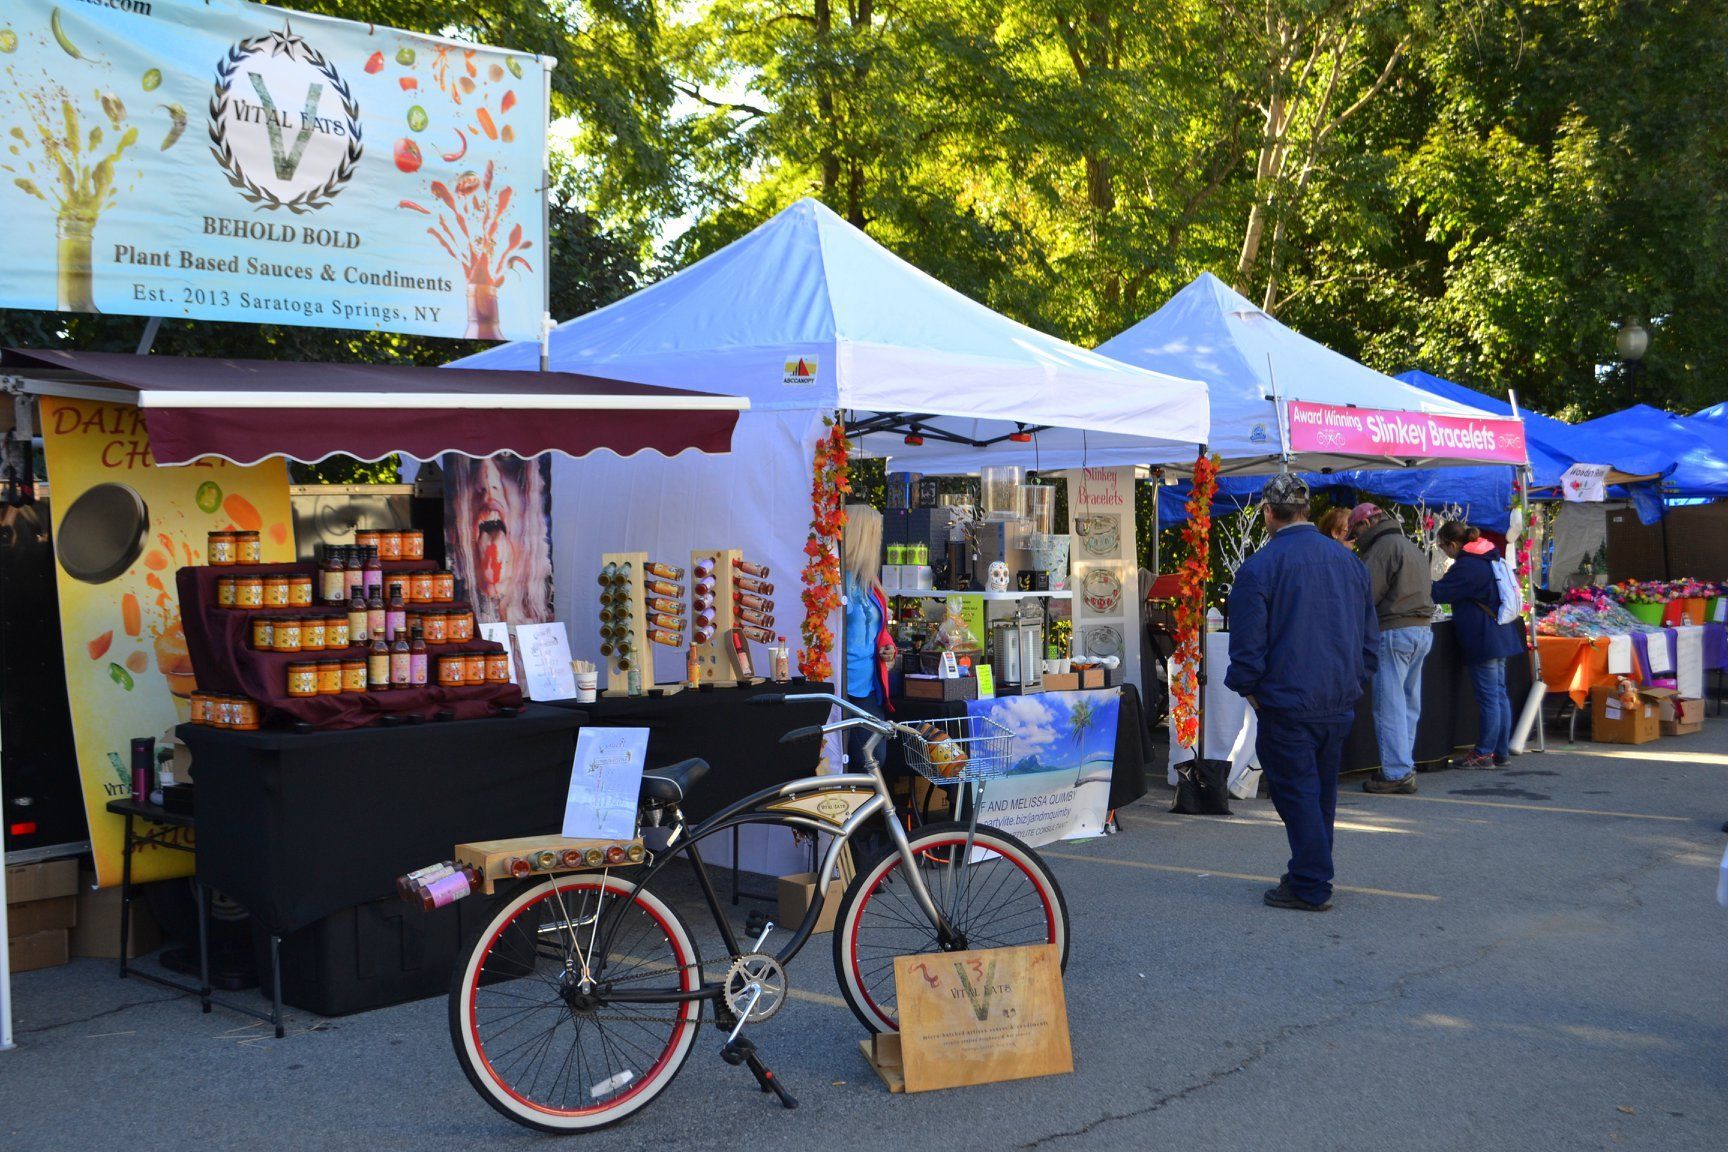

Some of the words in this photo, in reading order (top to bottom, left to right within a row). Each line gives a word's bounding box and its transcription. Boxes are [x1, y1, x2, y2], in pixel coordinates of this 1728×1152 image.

[233, 99, 293, 128] VITAL
[300, 111, 346, 136] EATS
[203, 216, 297, 243] BEHOLD
[302, 227, 361, 249] BOLD
[114, 244, 171, 267] Plant
[179, 250, 239, 273] Based
[247, 257, 313, 281] Sauces
[320, 264, 336, 282] &
[344, 266, 452, 292] Condiments
[133, 284, 173, 302] Est.
[183, 288, 230, 306] 2013
[240, 292, 323, 316] Saratoga
[332, 300, 407, 322] Springs,
[415, 306, 441, 322] NY
[52, 407, 149, 435] DAIR
[1293, 407, 1322, 424] Award
[1325, 409, 1363, 431] Winning
[1367, 416, 1427, 452] Slinkey
[1430, 420, 1496, 450] Bracelets
[1085, 467, 1118, 489] Slinkey
[1078, 485, 1124, 505] Bracelets
[987, 800, 1009, 812] AND
[1010, 795, 1048, 810] MELISSA
[1049, 790, 1078, 804] QUIMBY
